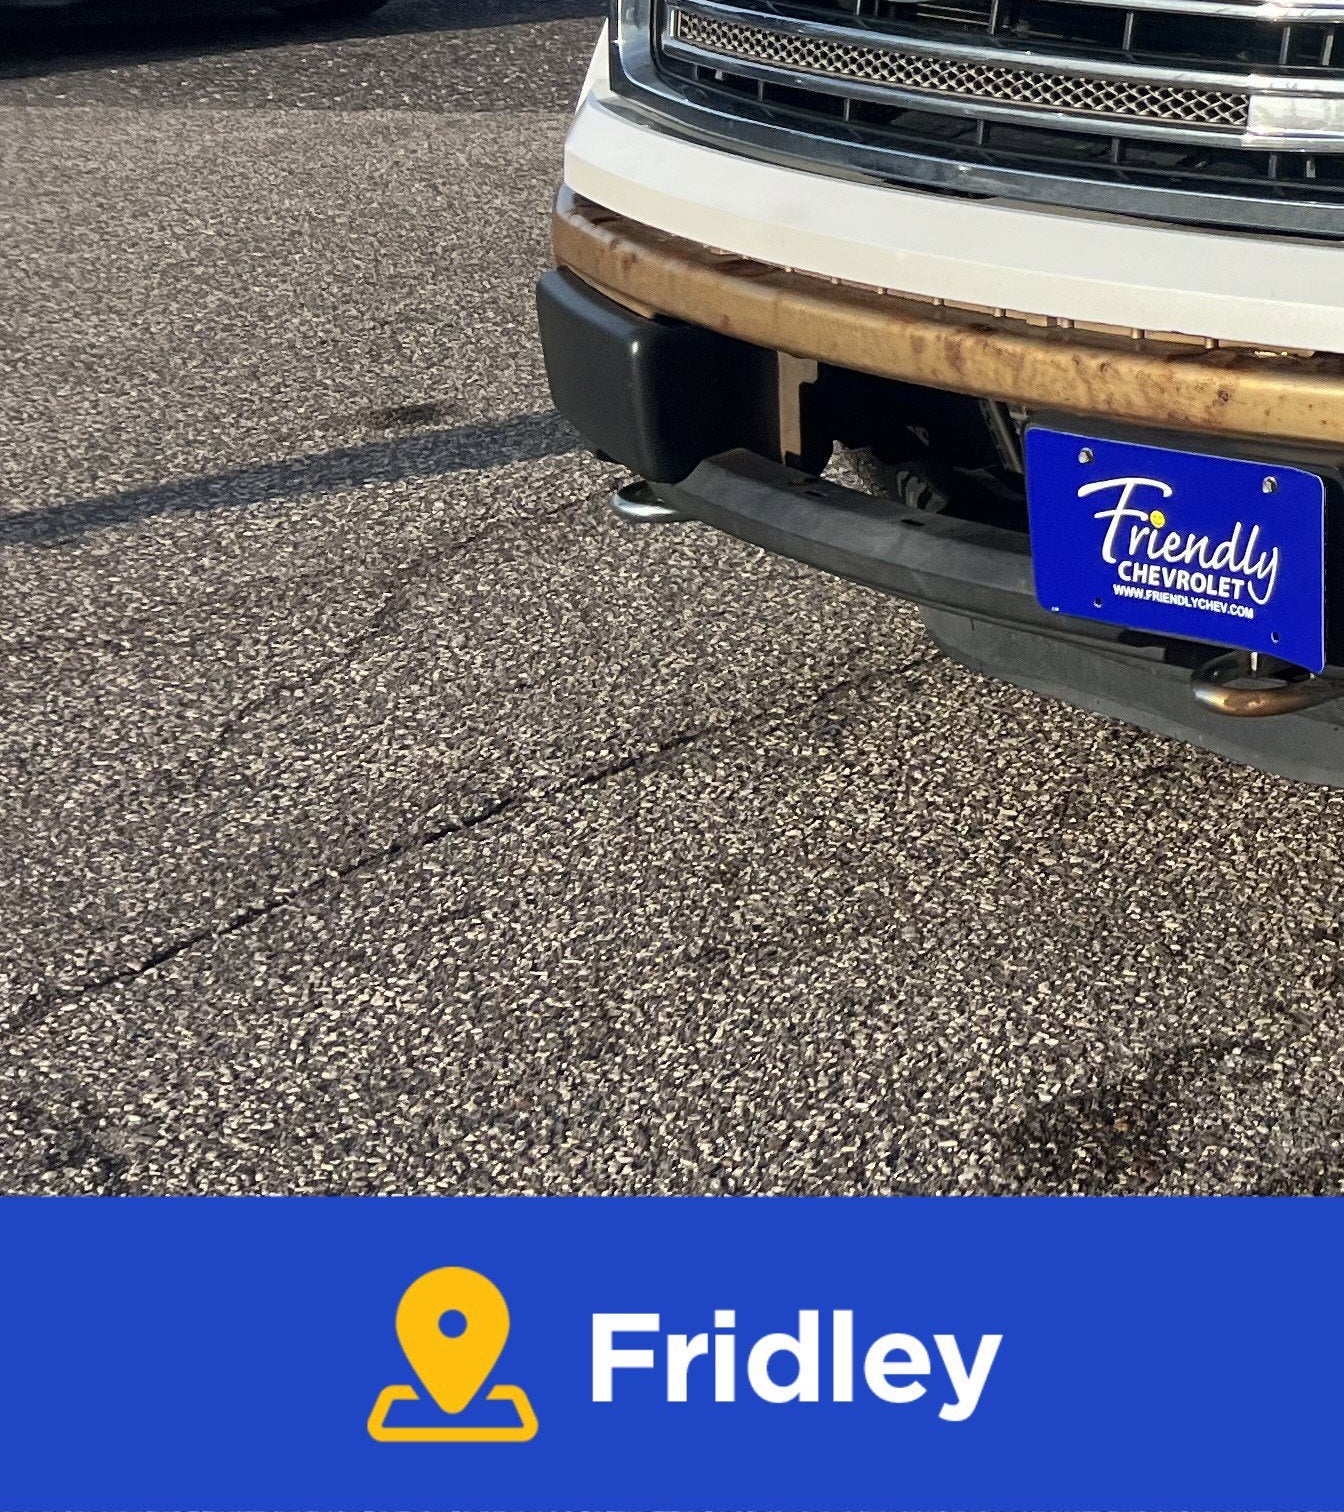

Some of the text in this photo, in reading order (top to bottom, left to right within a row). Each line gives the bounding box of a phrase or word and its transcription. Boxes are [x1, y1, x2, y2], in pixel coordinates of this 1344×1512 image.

[1077, 476, 1279, 605] Friendly
[1117, 560, 1245, 601] CHEVROLET
[1113, 584, 1254, 619] WWW.FRIENDLYCHEV.COM
